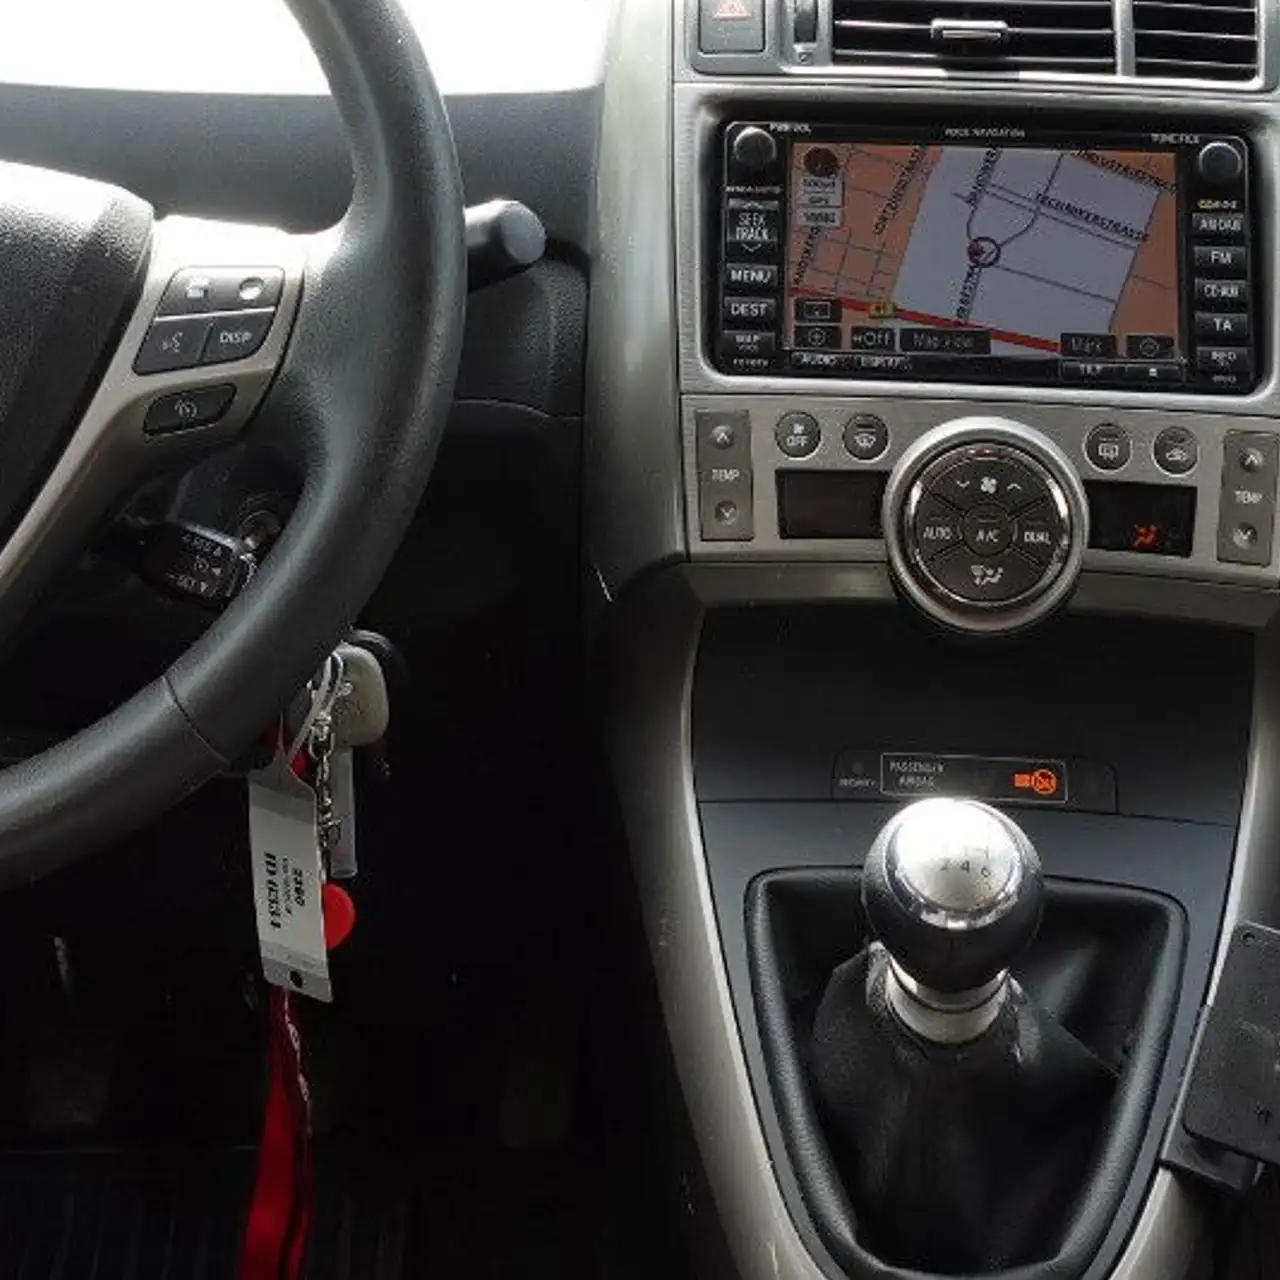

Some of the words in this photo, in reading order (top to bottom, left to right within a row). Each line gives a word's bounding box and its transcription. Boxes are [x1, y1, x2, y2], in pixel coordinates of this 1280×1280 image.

[738, 211, 766, 227] SEEK
[735, 226, 769, 241] TRACK
[1211, 251, 1232, 264] FM
[731, 269, 772, 283] MENU
[731, 303, 768, 317] DEST
[1213, 318, 1232, 332] TA
[220, 331, 253, 344] DISP
[786, 436, 808, 447] OFF
[712, 469, 740, 482] TEMP
[1234, 489, 1264, 505] TEMP
[923, 526, 953, 541] AUTO
[975, 529, 1002, 543] A/C
[1023, 531, 1052, 545] DUAL
